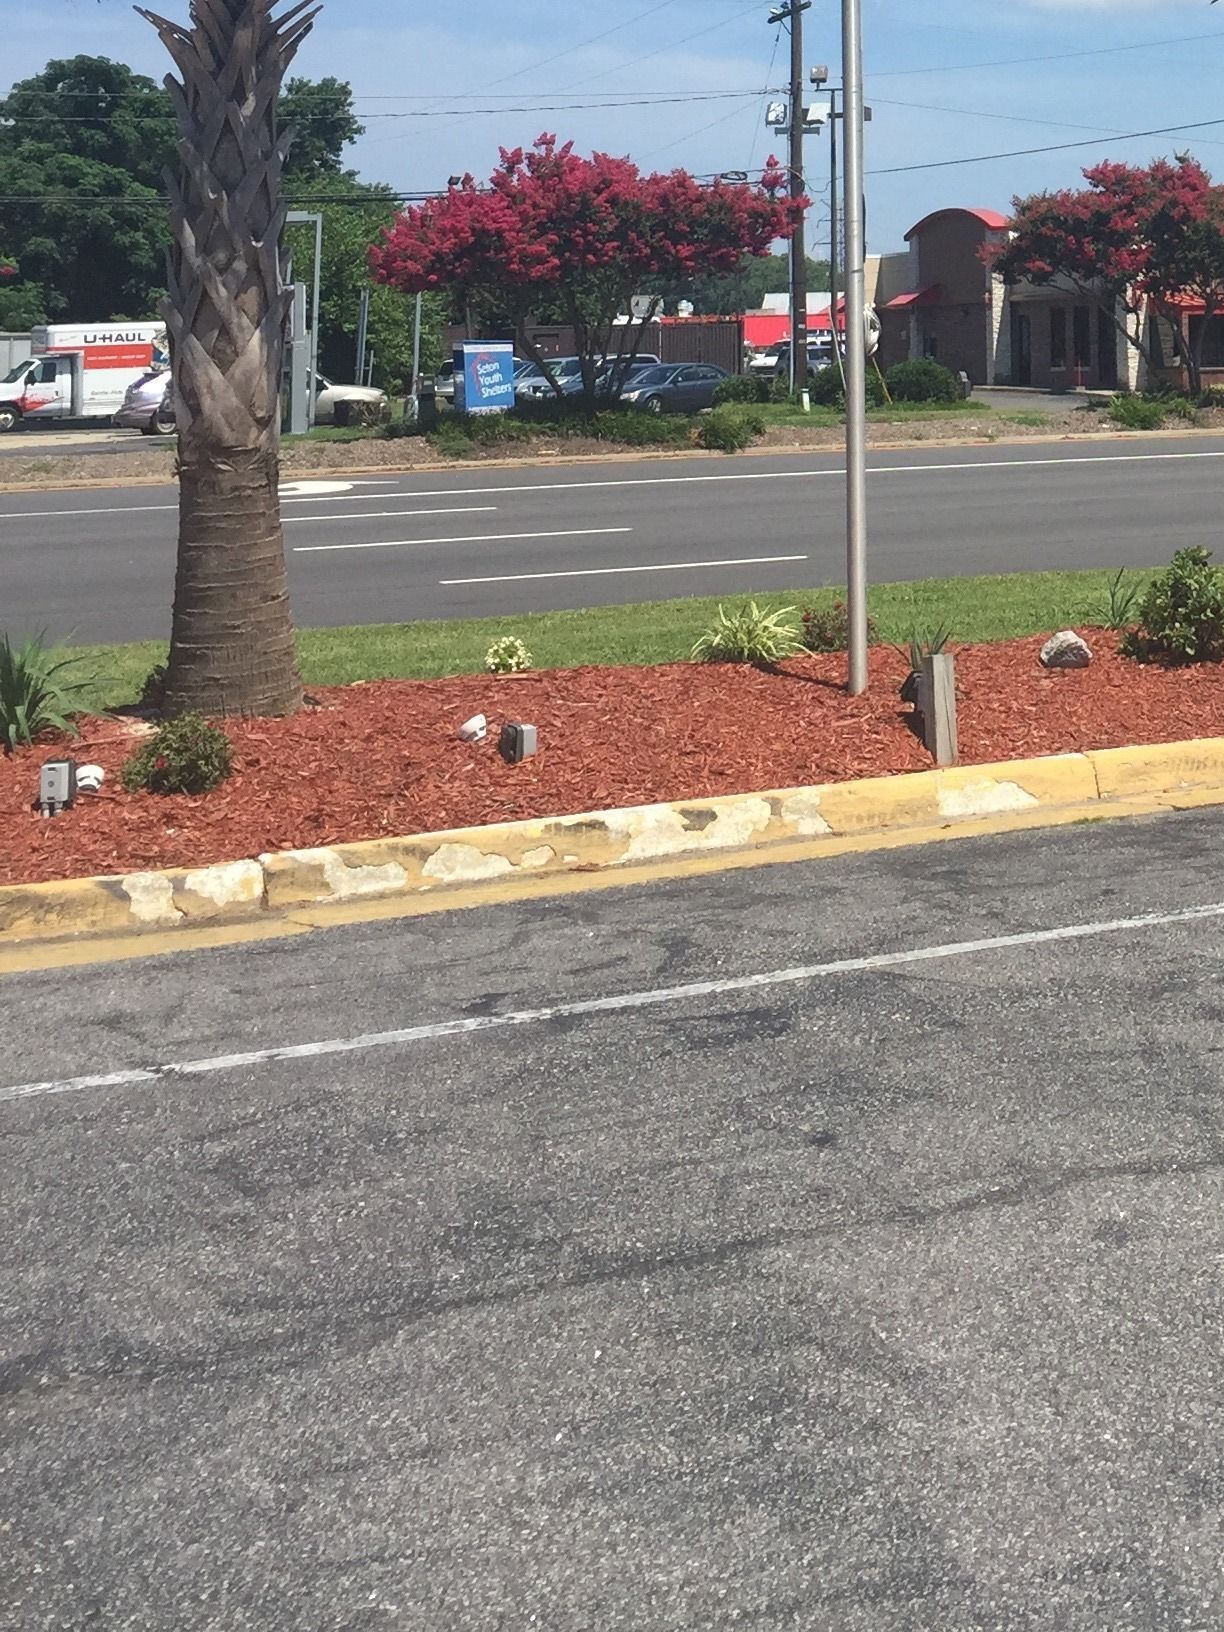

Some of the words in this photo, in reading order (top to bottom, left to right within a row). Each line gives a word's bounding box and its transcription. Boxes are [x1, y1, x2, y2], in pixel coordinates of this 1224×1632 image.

[84, 332, 146, 343] U-HAUL
[476, 362, 500, 375] Seton
[479, 373, 503, 385] Youth
